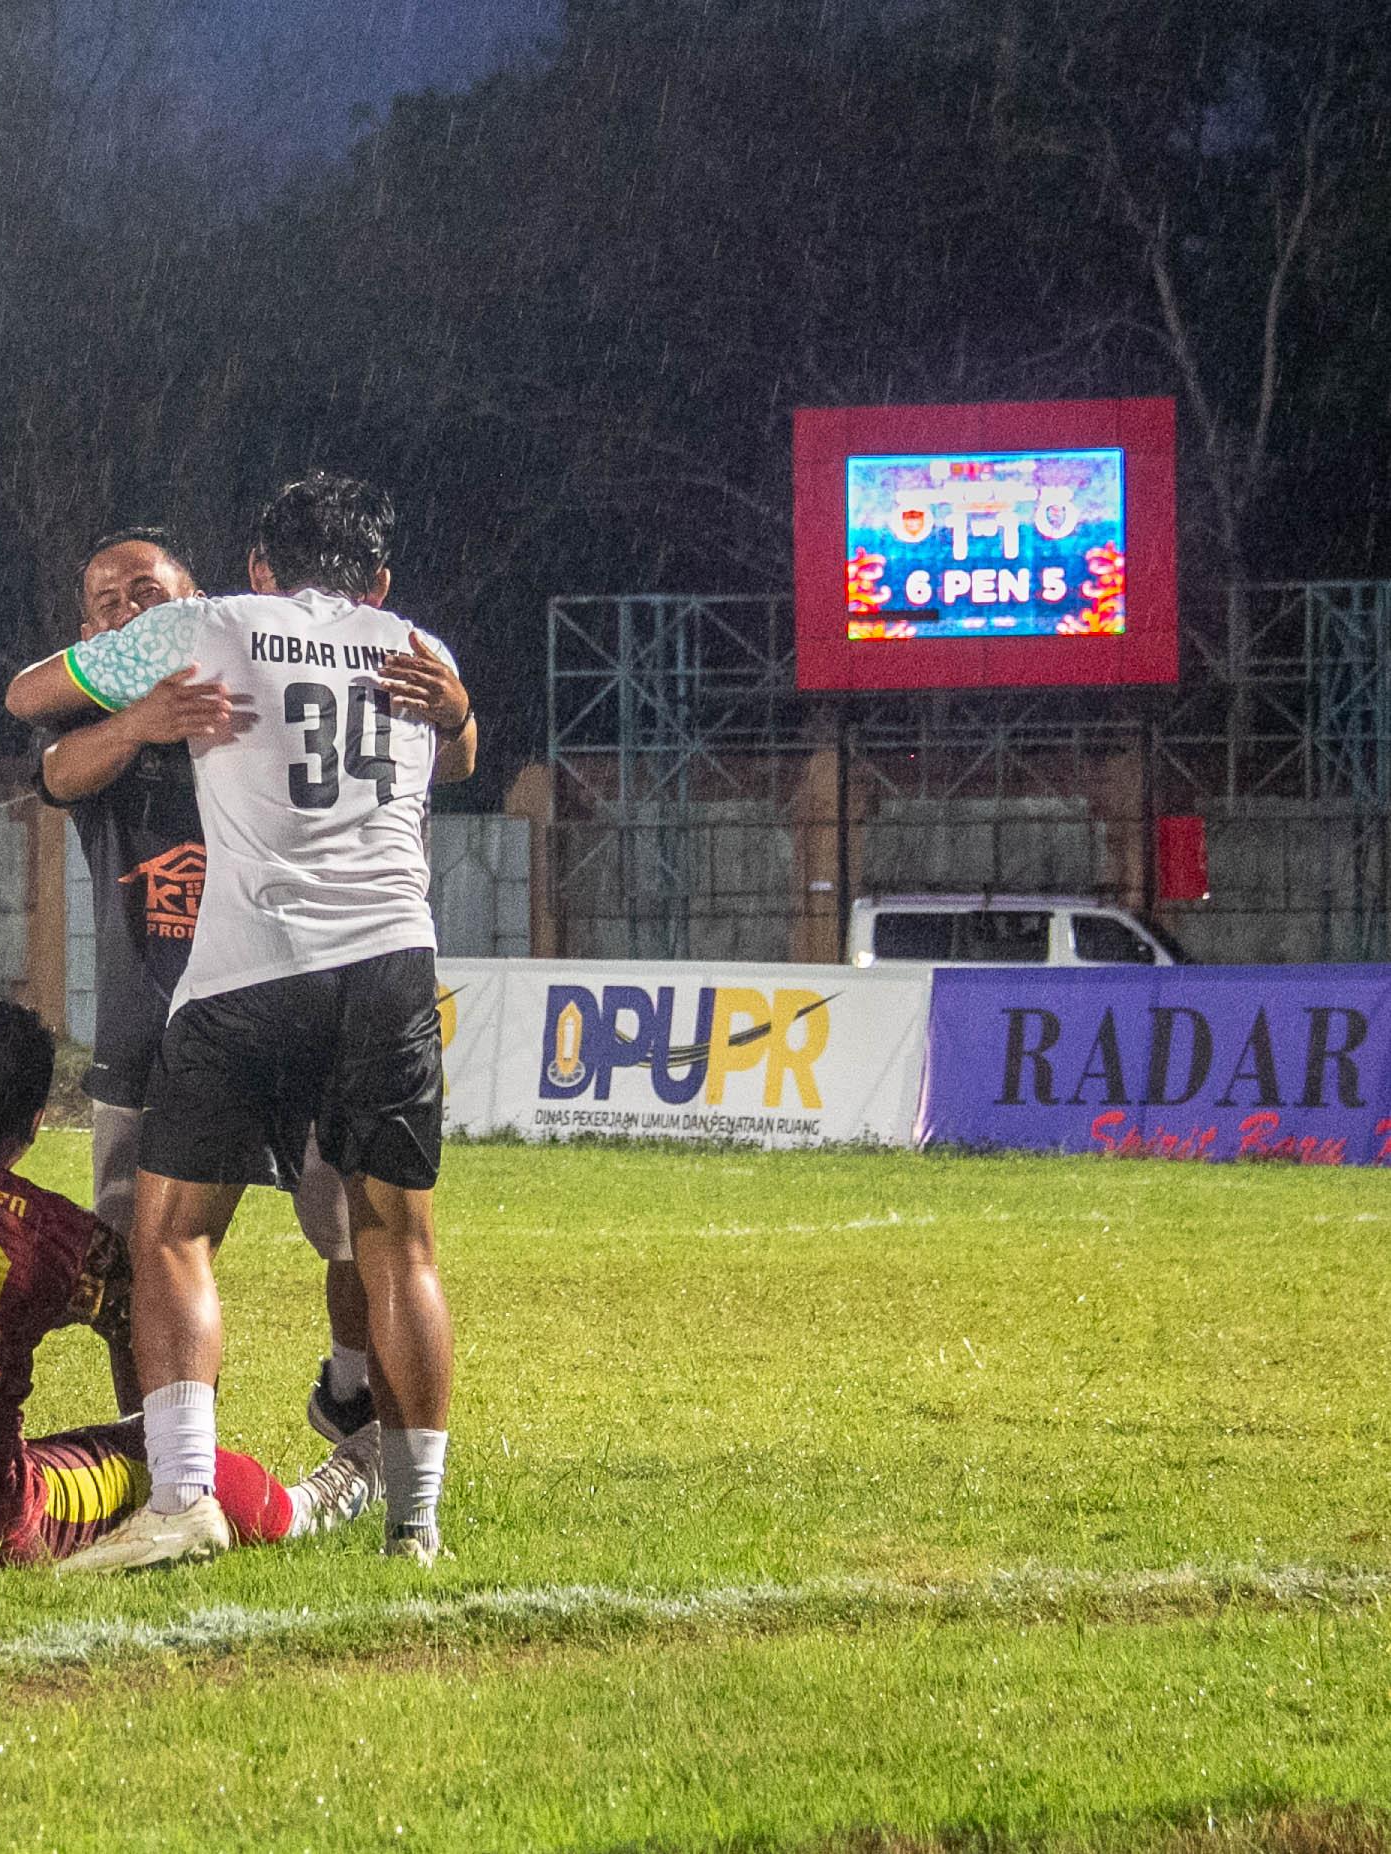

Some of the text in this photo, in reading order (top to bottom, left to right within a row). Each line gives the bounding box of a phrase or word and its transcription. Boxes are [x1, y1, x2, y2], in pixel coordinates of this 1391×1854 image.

[906, 567, 1067, 604] 6 PEN 5
[251, 631, 337, 668] KOBAR
[283, 682, 397, 809] 34
[539, 985, 831, 1109] DPUPR
[994, 1006, 1368, 1108] RADAR
[535, 1109, 820, 1136] DINAS PEKERJAAN UMUM DAN PENATAAN RUANG
